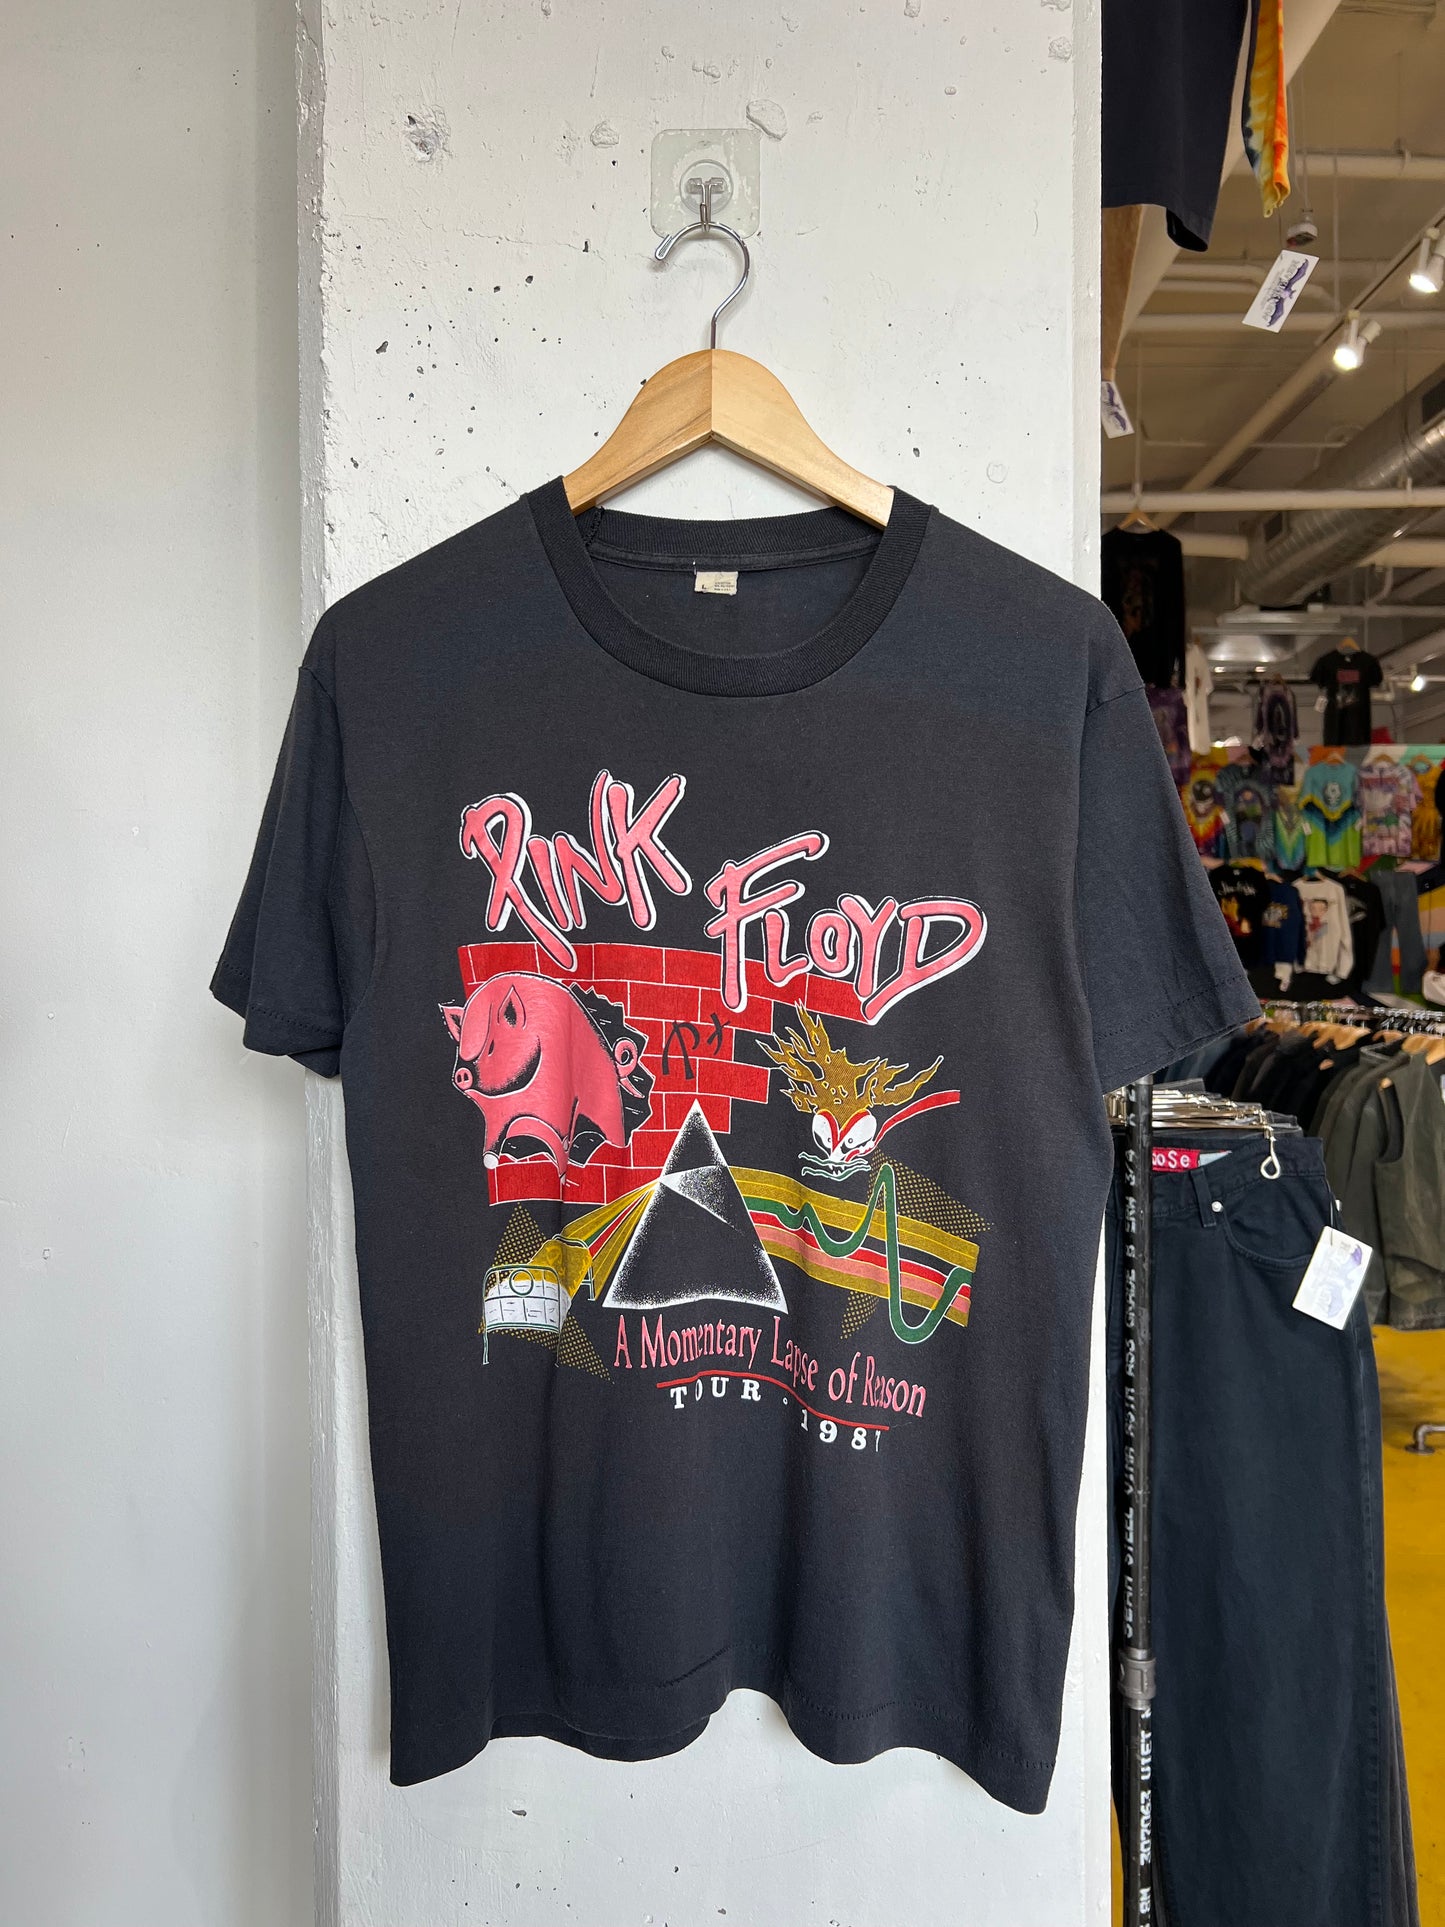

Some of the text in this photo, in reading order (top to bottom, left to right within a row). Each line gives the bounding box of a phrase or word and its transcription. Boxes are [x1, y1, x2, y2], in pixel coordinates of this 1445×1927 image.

[460, 769, 988, 1026] PINK FLOYD
[614, 1314, 927, 1418] A Momentary Lapse of Reason
[670, 1376, 761, 1409] TOUR
